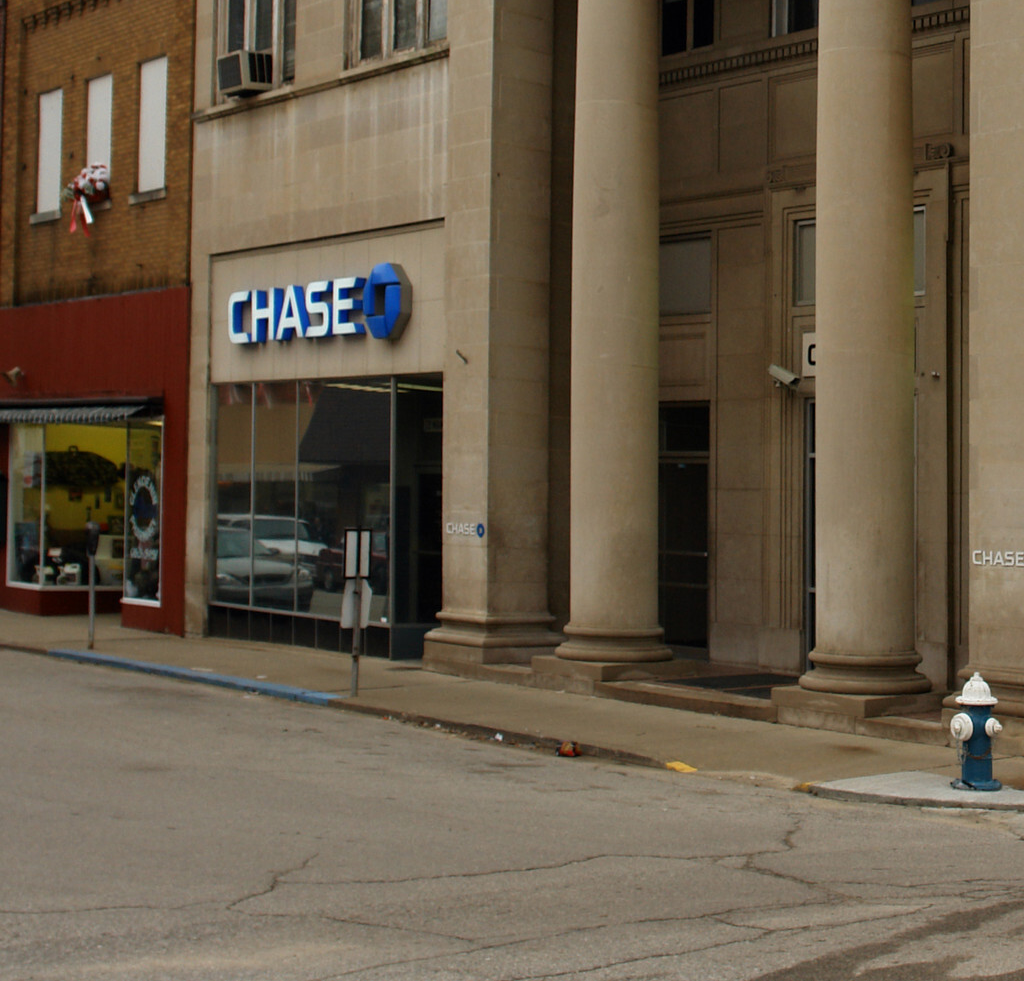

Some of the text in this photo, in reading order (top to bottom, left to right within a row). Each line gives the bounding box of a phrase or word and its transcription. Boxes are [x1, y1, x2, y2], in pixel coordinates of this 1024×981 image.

[228, 277, 362, 344] CHASE
[446, 523, 476, 535] CHASE
[972, 550, 1024, 567] CHASE
